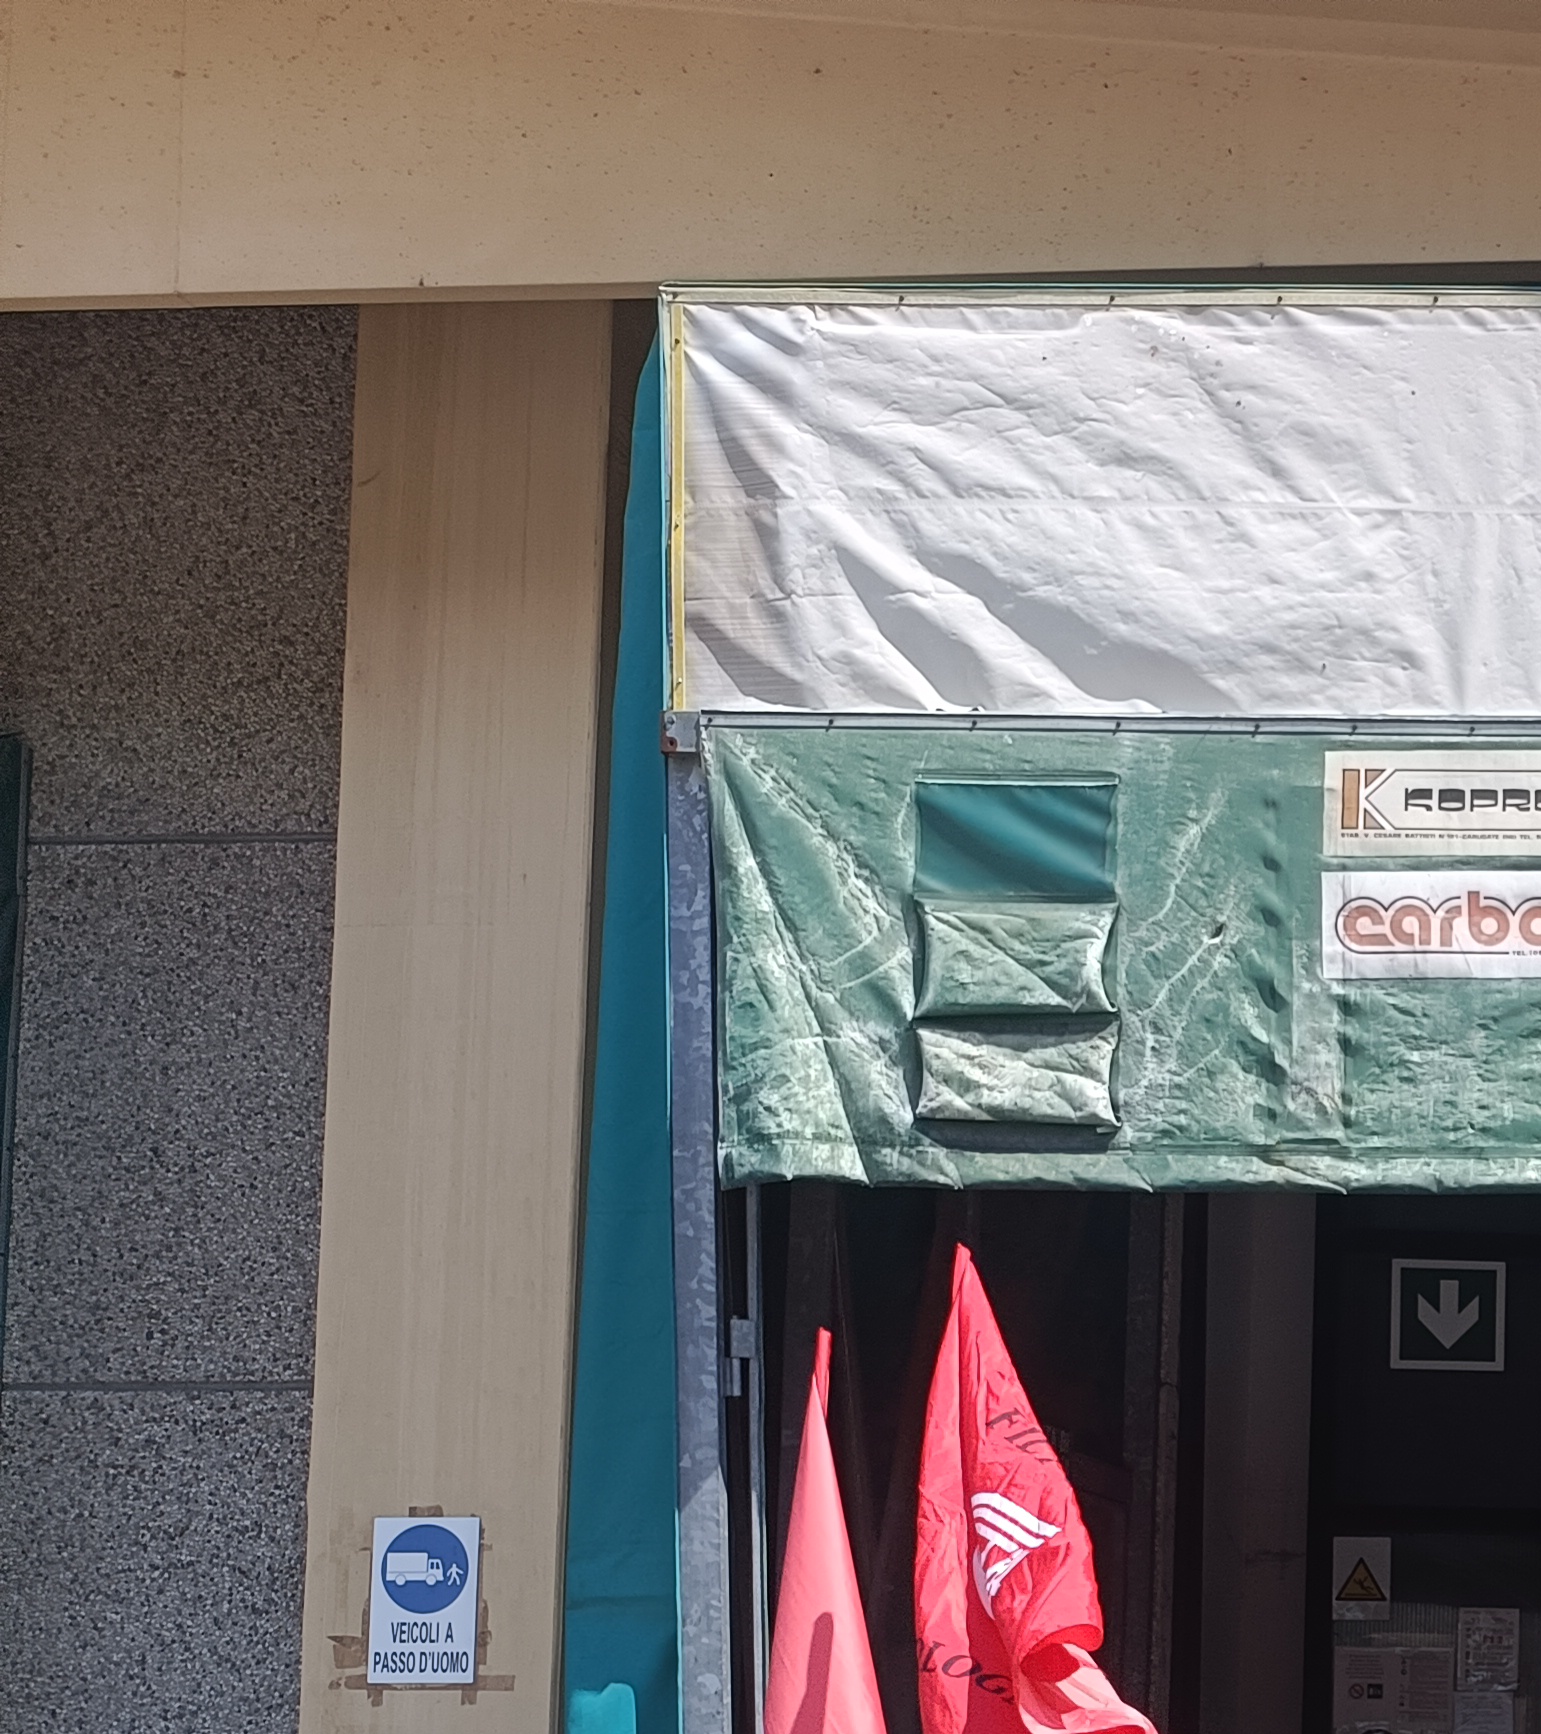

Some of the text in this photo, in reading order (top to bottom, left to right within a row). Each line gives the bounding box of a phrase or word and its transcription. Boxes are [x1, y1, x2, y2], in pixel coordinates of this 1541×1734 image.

[390, 1621, 454, 1644] VEICOLI A
[372, 1651, 470, 1674] PASSO D'UOMO
